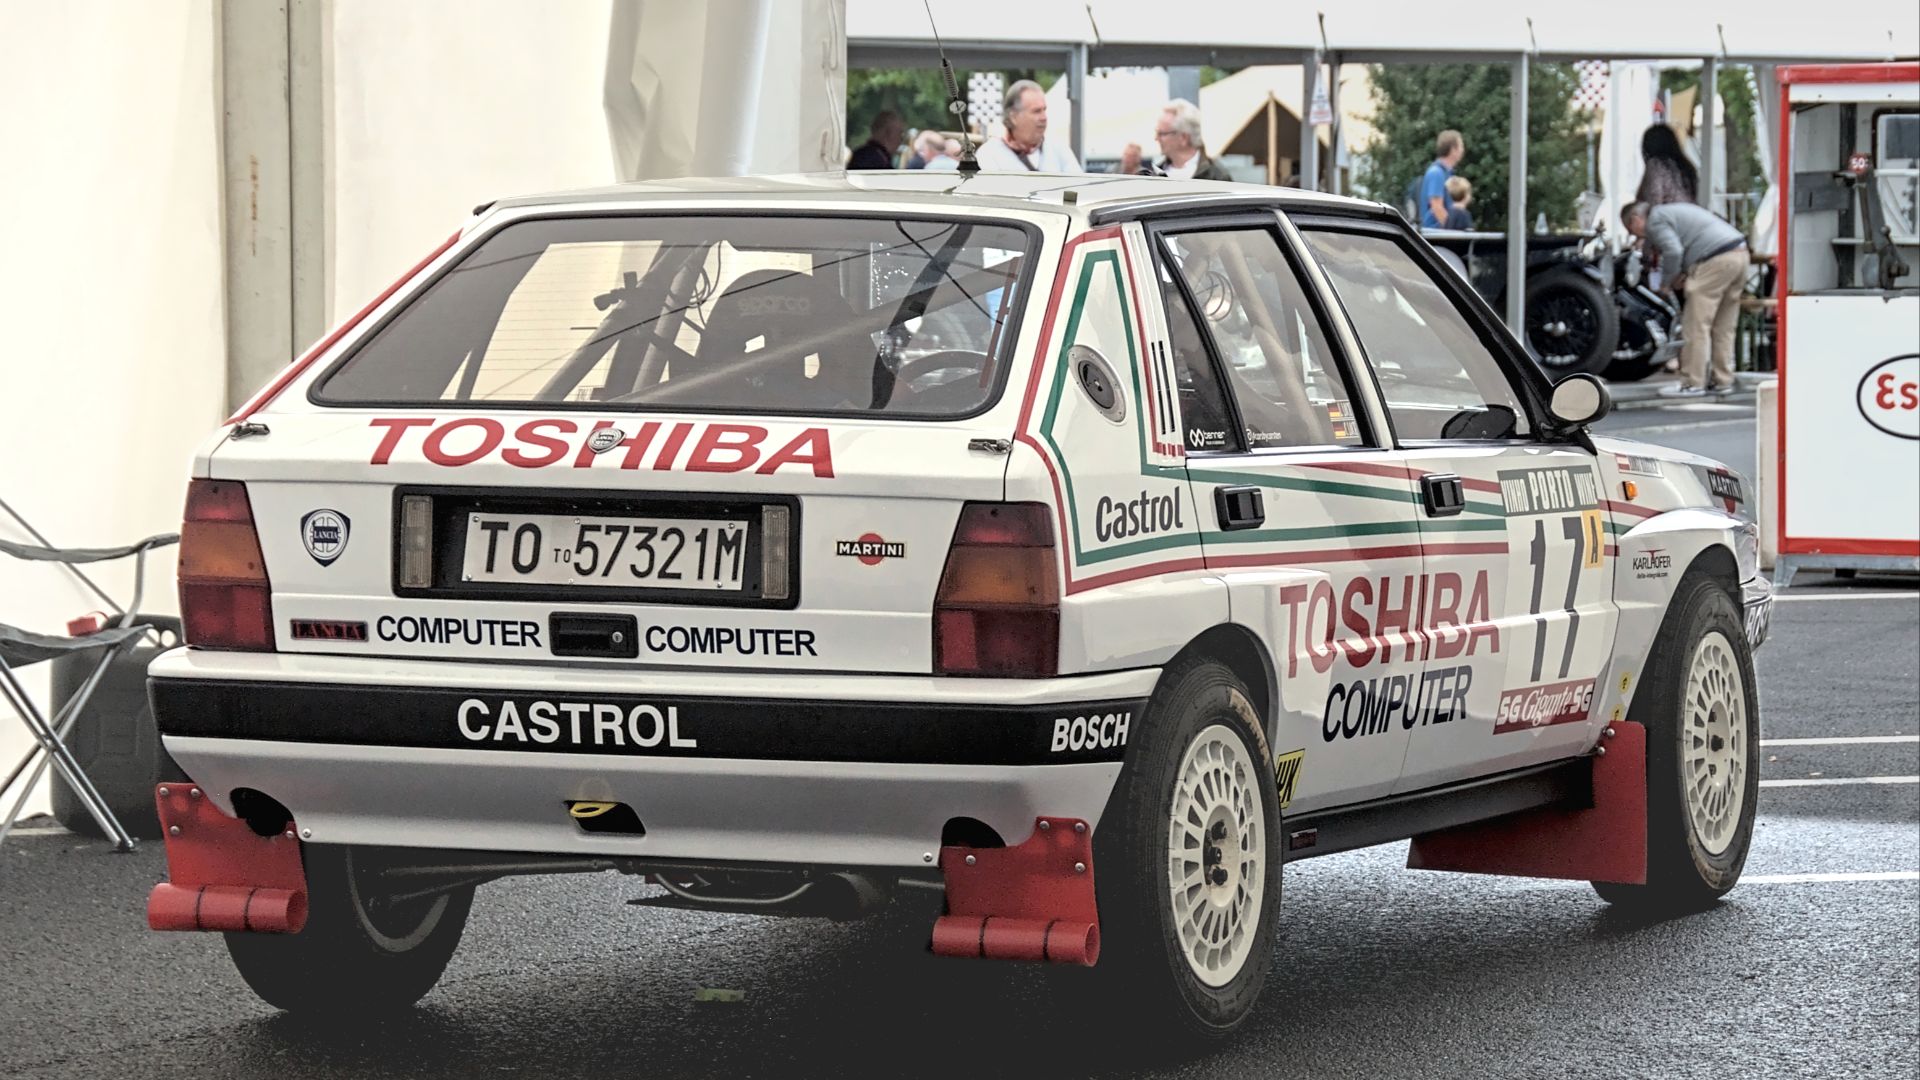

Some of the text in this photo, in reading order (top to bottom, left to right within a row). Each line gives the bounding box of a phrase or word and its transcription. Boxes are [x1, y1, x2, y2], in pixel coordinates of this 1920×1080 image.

[368, 418, 836, 479] TOSHIBA
[1527, 469, 1575, 511] PORTO
[1710, 474, 1743, 502] MARTINI
[313, 529, 339, 540] LANCIA
[1096, 486, 1184, 543] Castrol
[480, 521, 542, 575] TO
[573, 524, 744, 581] 57321M
[838, 542, 904, 557] MARTINI
[1632, 555, 1672, 570] KARLHOFER
[1529, 516, 1585, 683] 17
[294, 622, 363, 640] LANCIA
[376, 615, 543, 648] COMPUTER
[644, 625, 818, 657] COMPUTER
[1279, 569, 1501, 679] TOSHIBA
[456, 698, 698, 749] CASTROL
[1321, 664, 1473, 743] COMPUTER
[1495, 683, 1594, 727] SG Gigante SG
[1051, 712, 1131, 752] BOSCH
